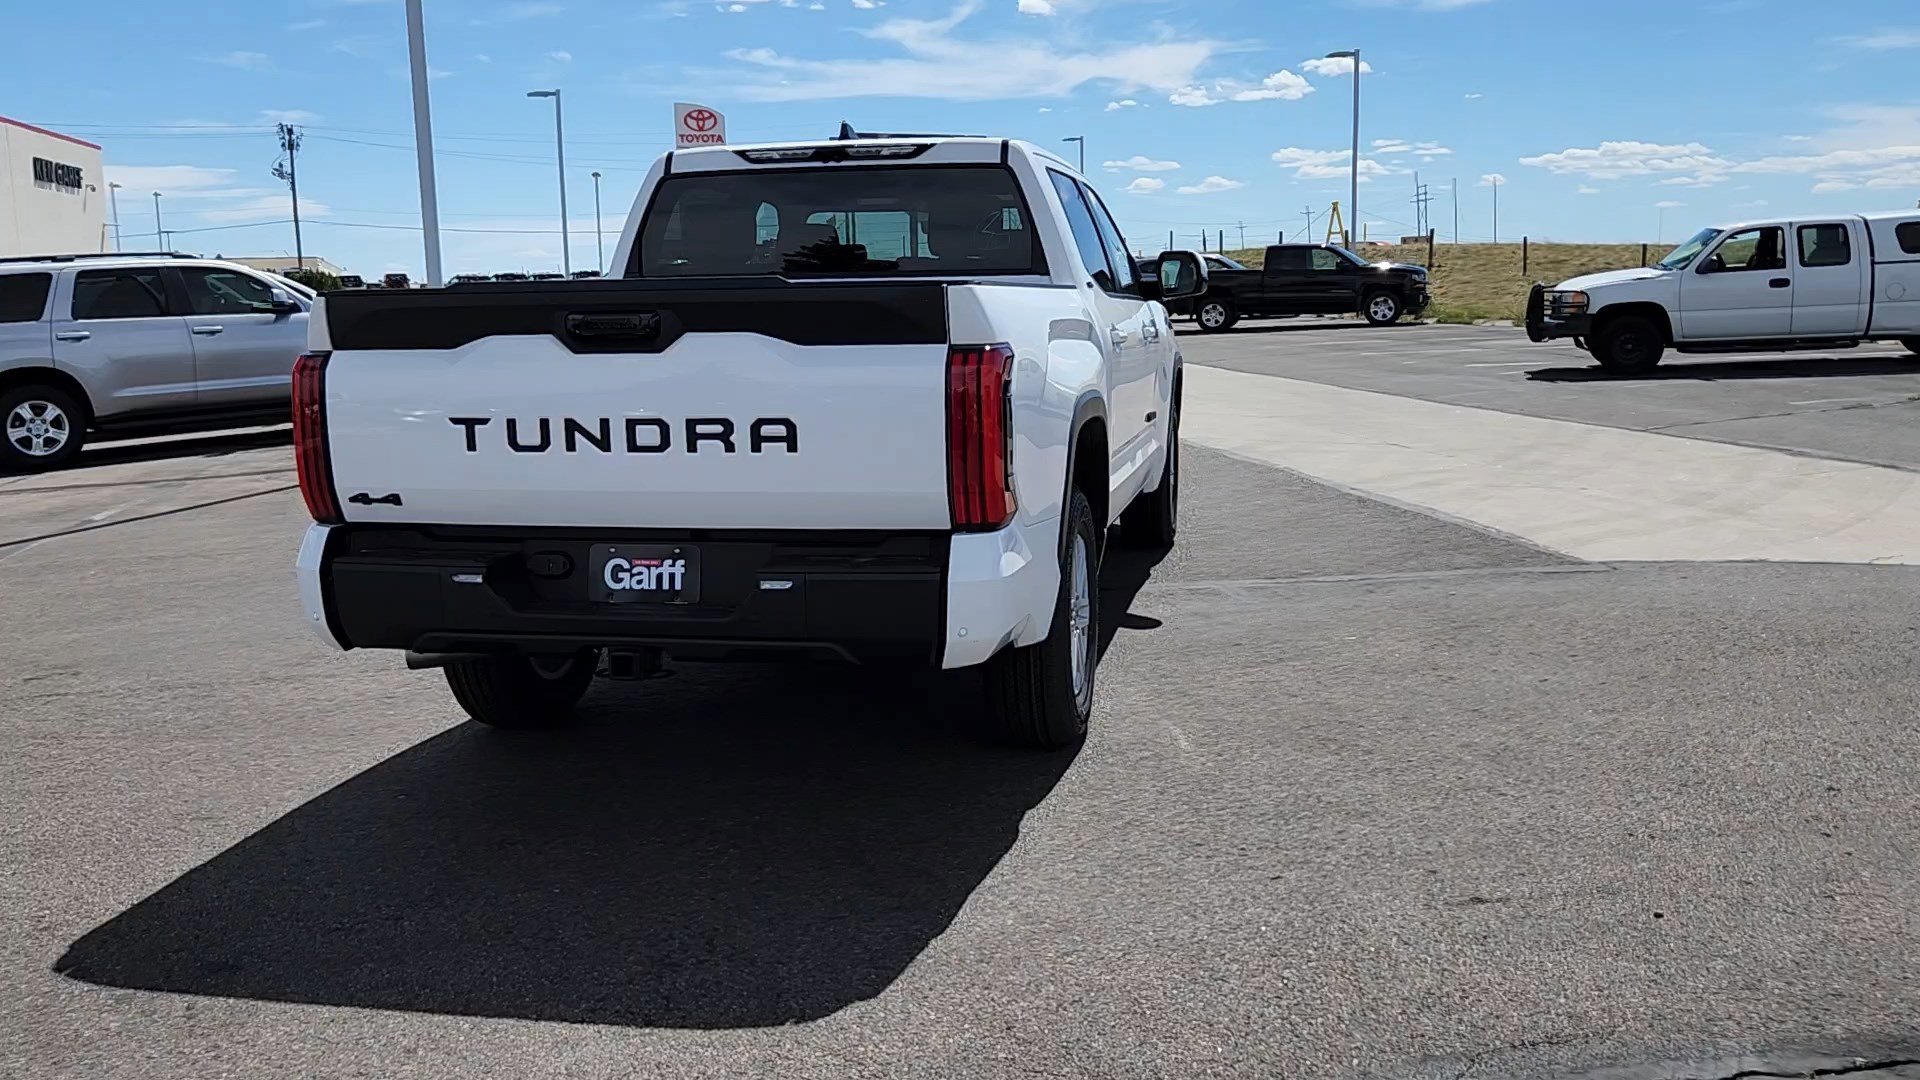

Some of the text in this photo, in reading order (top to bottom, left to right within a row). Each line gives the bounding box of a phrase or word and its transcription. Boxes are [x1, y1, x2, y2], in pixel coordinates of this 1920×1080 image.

[679, 134, 724, 143] TOYOTA
[33, 156, 54, 183] KEN
[448, 417, 798, 454] TUNDRA
[604, 557, 686, 591] Garff
